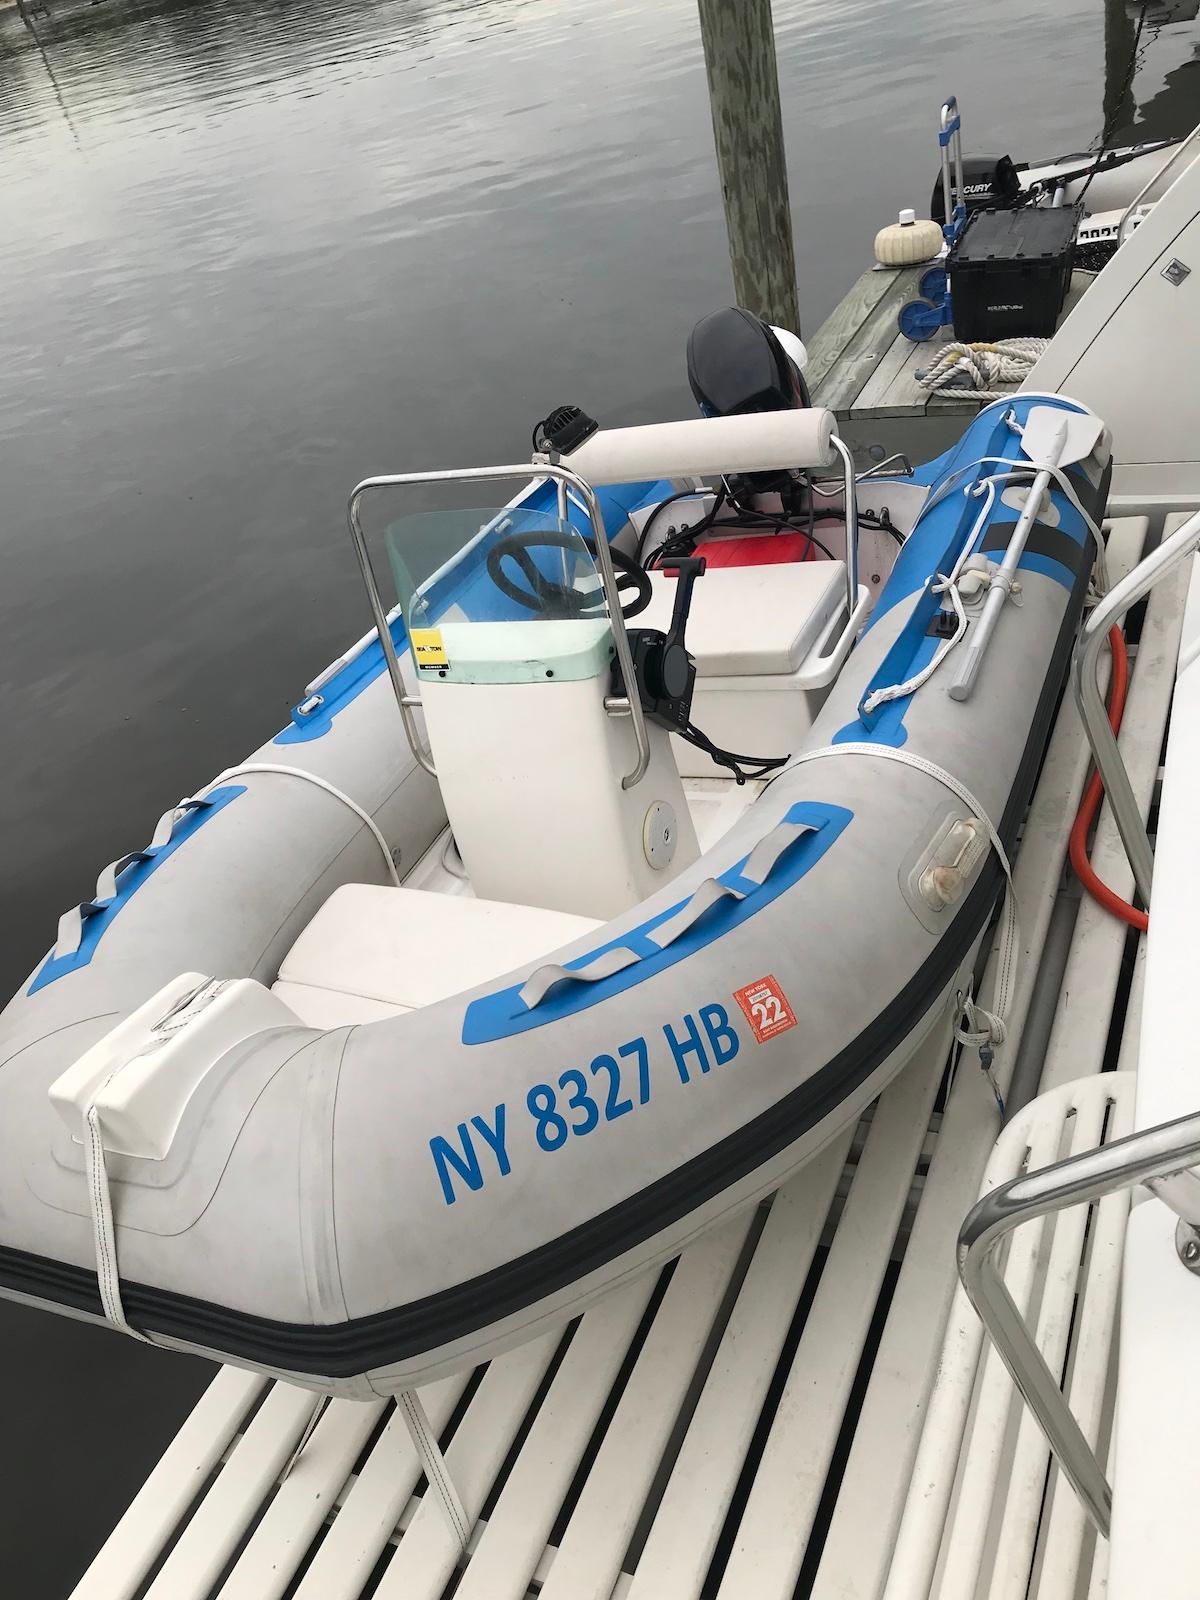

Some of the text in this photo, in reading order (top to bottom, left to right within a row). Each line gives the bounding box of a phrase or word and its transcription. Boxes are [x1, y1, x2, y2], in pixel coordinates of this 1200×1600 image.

[751, 996, 787, 1030] 22
[429, 1003, 740, 1205] NY 8327 HB
